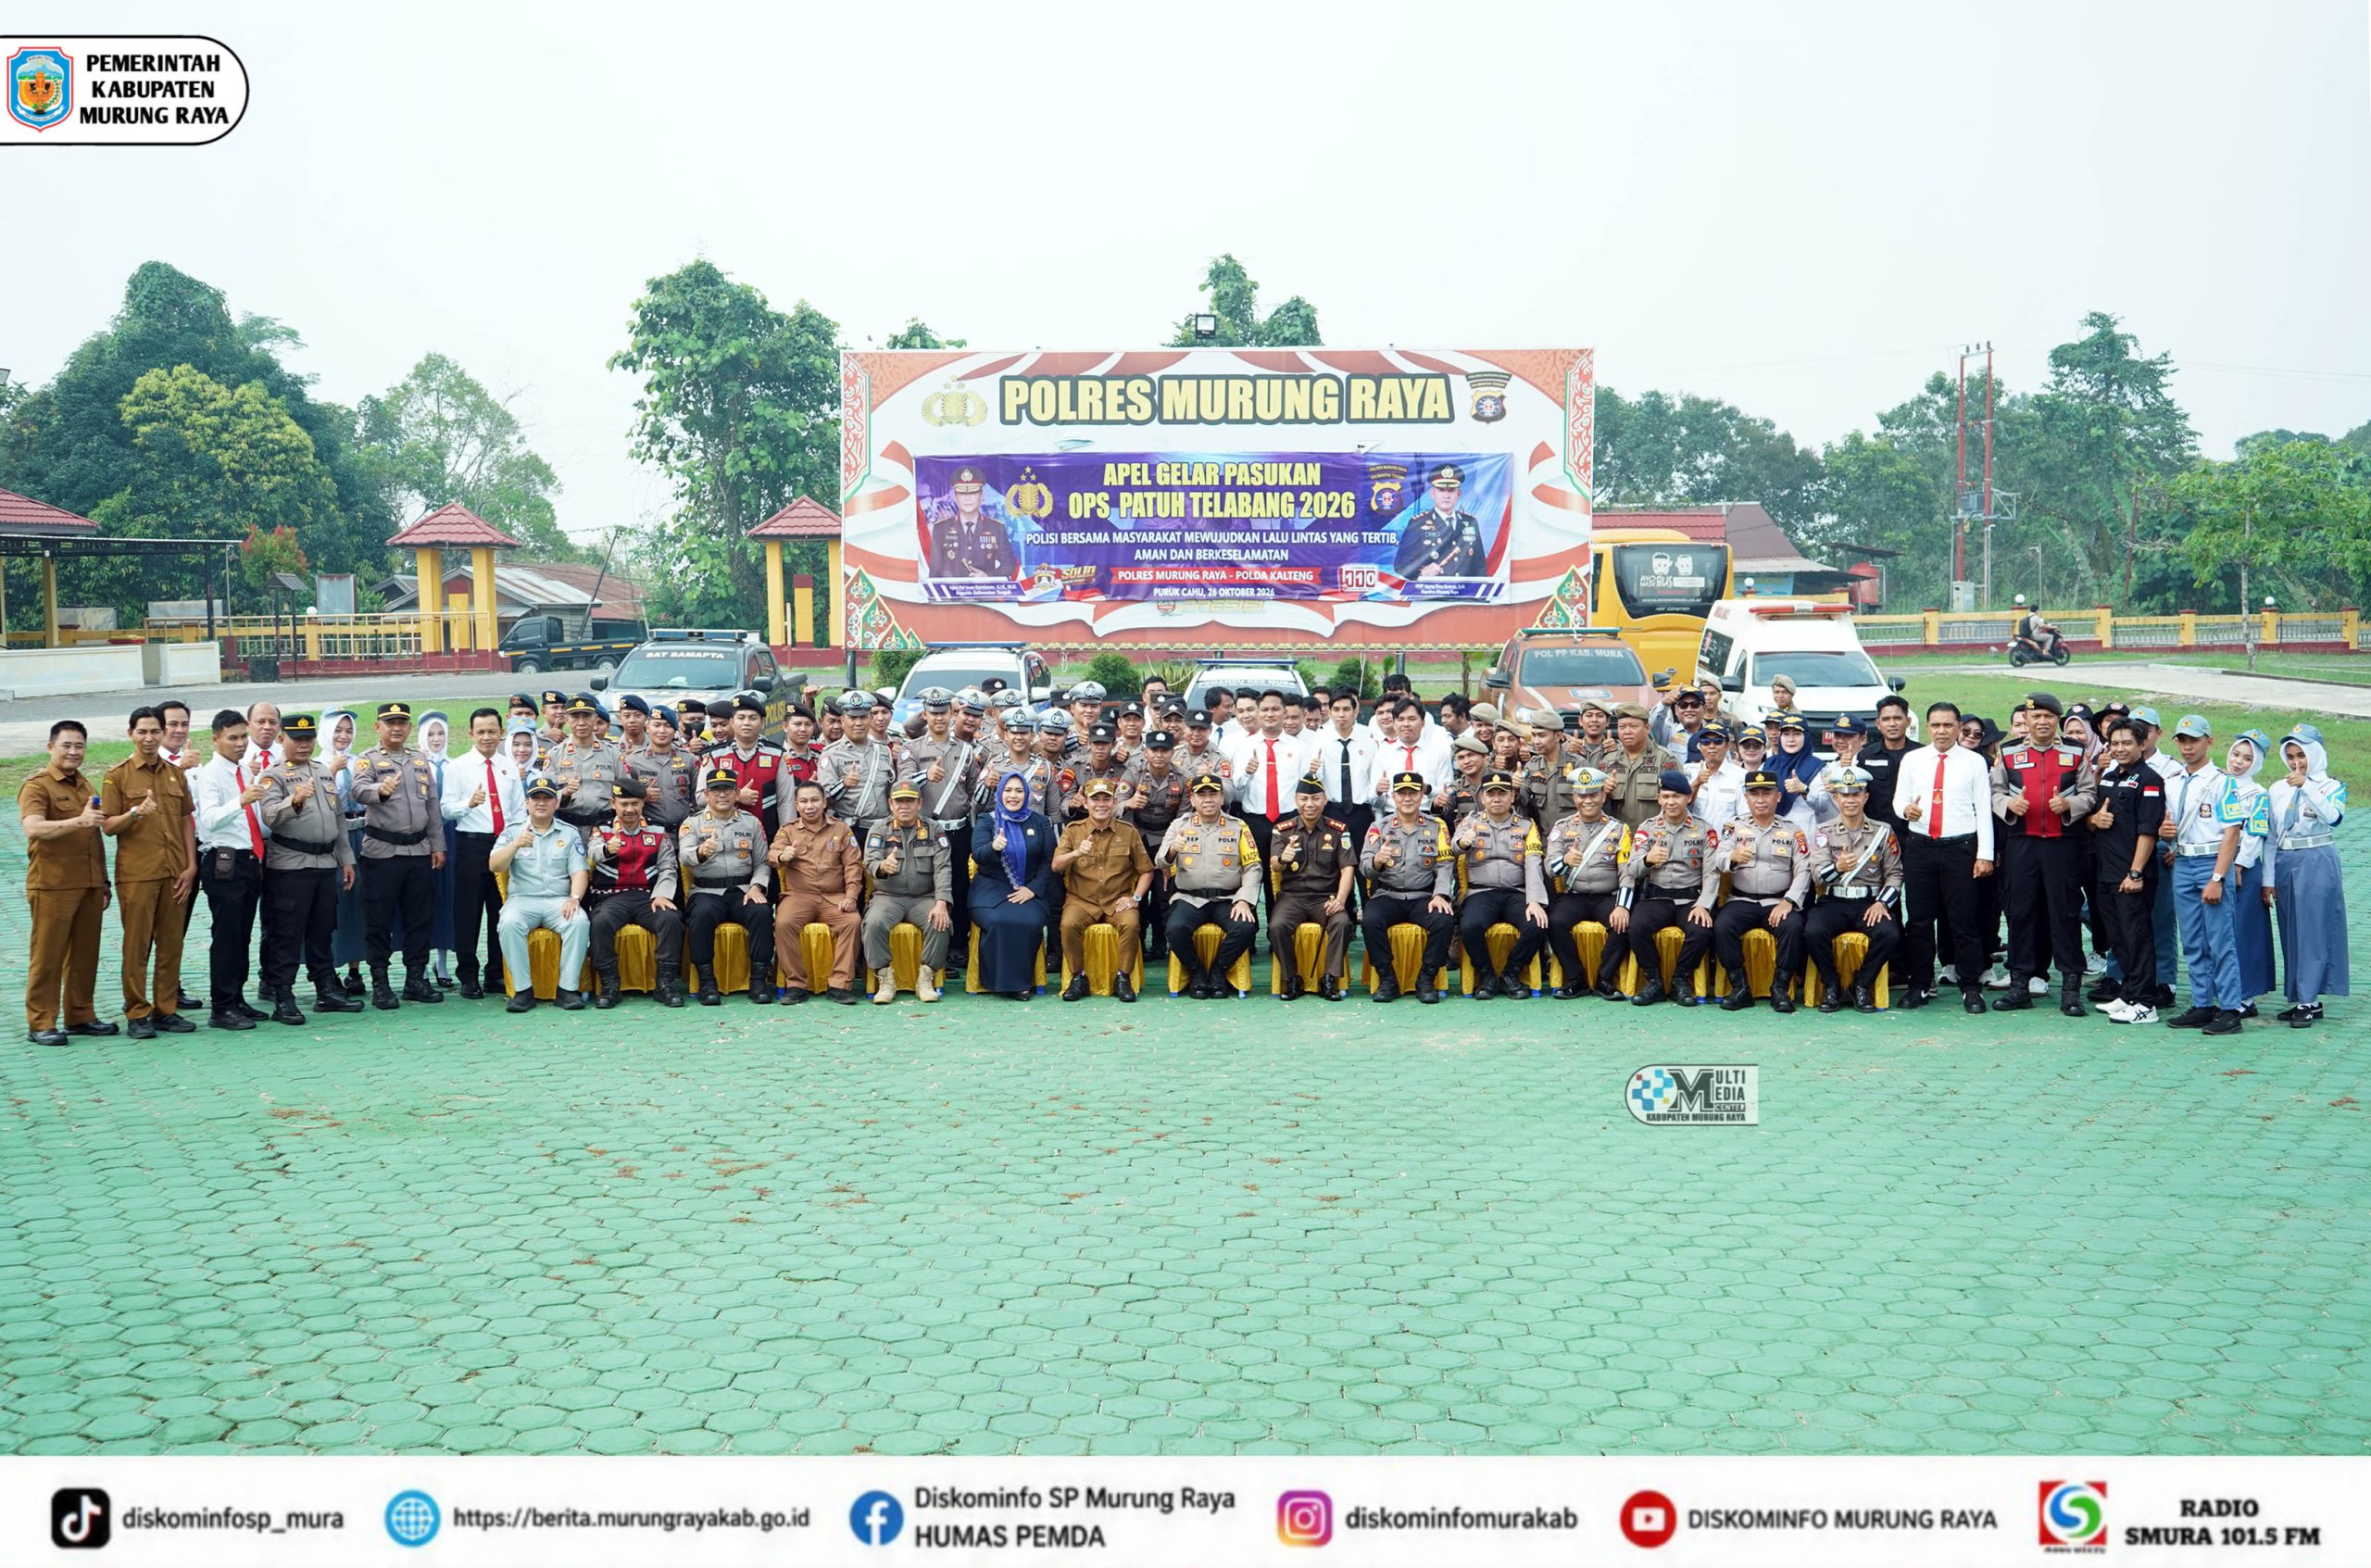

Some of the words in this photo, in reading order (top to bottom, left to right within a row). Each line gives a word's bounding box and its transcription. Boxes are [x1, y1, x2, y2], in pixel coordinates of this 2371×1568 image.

[1002, 377, 1154, 423] POLRES
[1160, 376, 1340, 422] MURUNG
[1349, 375, 1450, 420] RAYA
[1103, 462, 1152, 486] APEL
[1156, 462, 1220, 486] GELAR
[1224, 462, 1321, 486] PASUKAN
[1069, 491, 1110, 519] OPS
[1119, 491, 1186, 519] PATUH
[1189, 491, 1296, 519] TELABANG
[1299, 491, 1356, 519] 2026
[1026, 533, 1059, 545] POLISI
[1060, 532, 1110, 544] BERSAMA
[1112, 532, 1182, 544] MASYARAKAT
[1185, 532, 1261, 544] MEWUJUDKAN
[1262, 532, 1288, 544] LALU
[1291, 532, 1327, 544] LINTAS
[1329, 532, 1359, 544] YANG
[1361, 532, 1399, 545] TERTIB,
[1134, 549, 1168, 560] AMAN
[1170, 549, 1193, 560] DAN
[1196, 548, 1289, 560] BERKESELAMATAN
[1118, 571, 1153, 581] POLRES
[1156, 571, 1200, 581] MURUNG
[1202, 571, 1227, 581] RAYA
[1236, 571, 1268, 581] POLDA
[1270, 571, 1313, 581] KALTENG
[1345, 571, 1375, 586] 110
[1153, 588, 1180, 597] PURUK
[1181, 588, 1206, 598] CAHU,
[1219, 587, 1255, 596] OKTOBER
[1534, 650, 1553, 659] POL
[1596, 650, 1624, 659] MURA
[765, 700, 786, 726] POLISI
